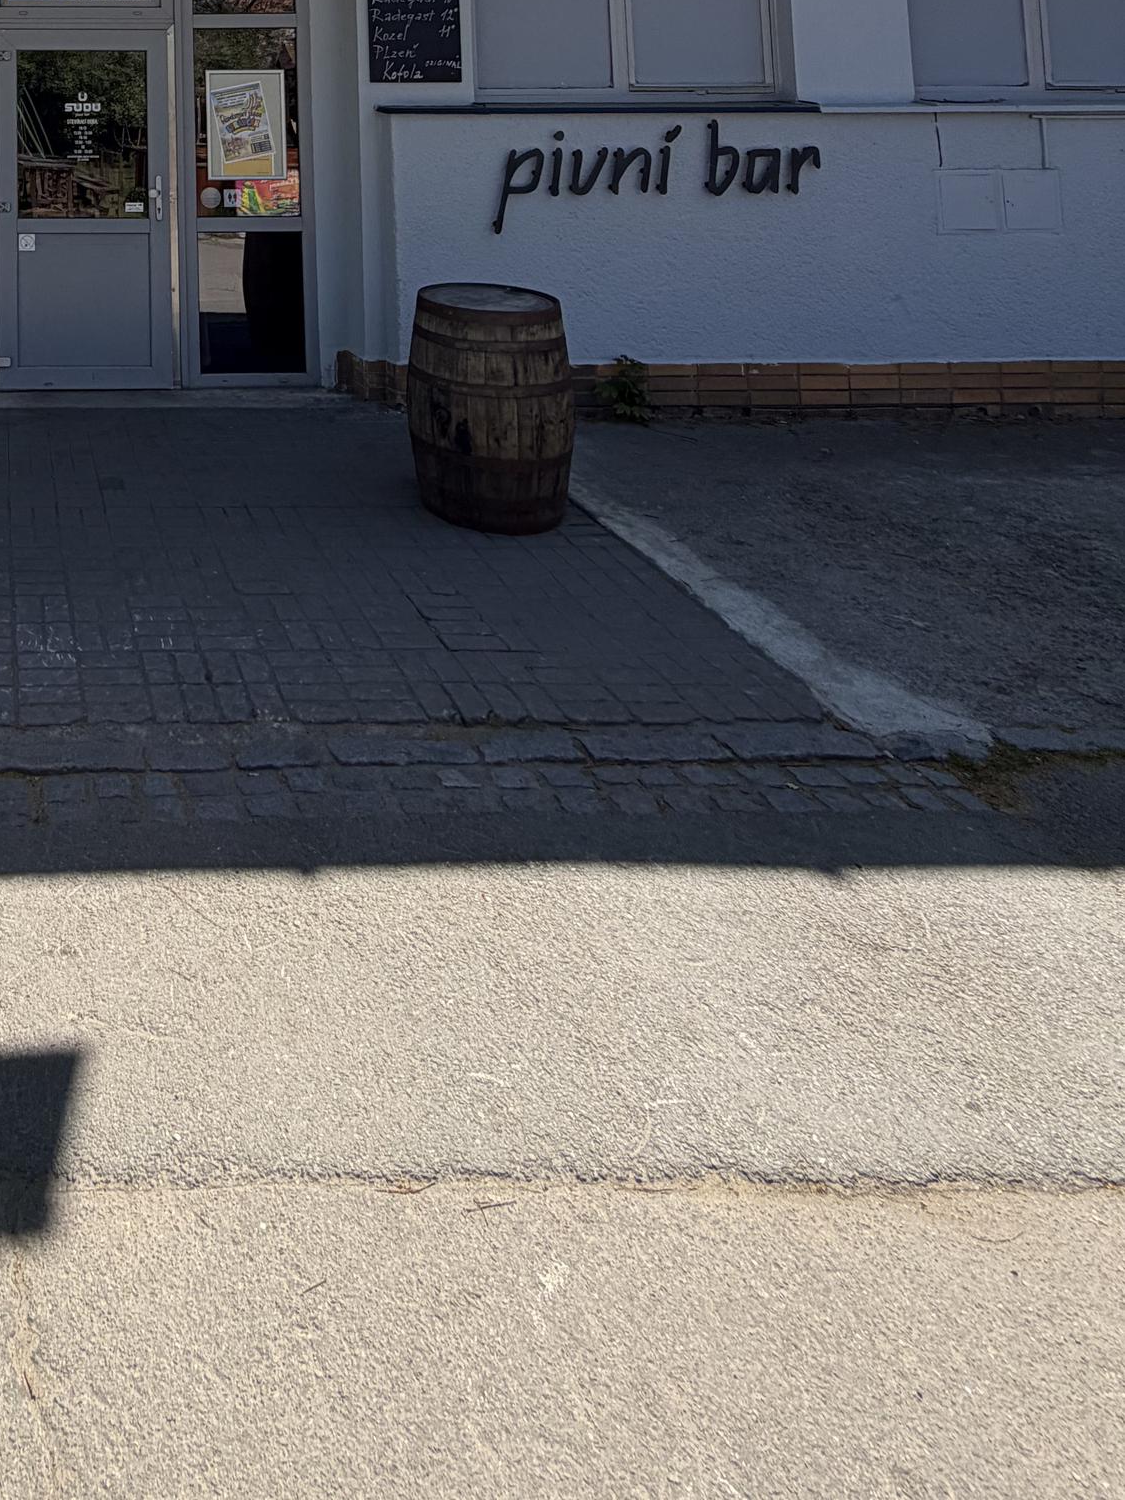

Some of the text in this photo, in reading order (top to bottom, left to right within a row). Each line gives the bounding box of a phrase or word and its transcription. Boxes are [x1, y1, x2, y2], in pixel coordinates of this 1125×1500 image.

[369, 8, 436, 26] Radegast
[372, 24, 410, 42] Kozel
[382, 60, 424, 83] Kofola
[64, 102, 101, 112] SUDU
[492, 119, 821, 235] pivní bar
